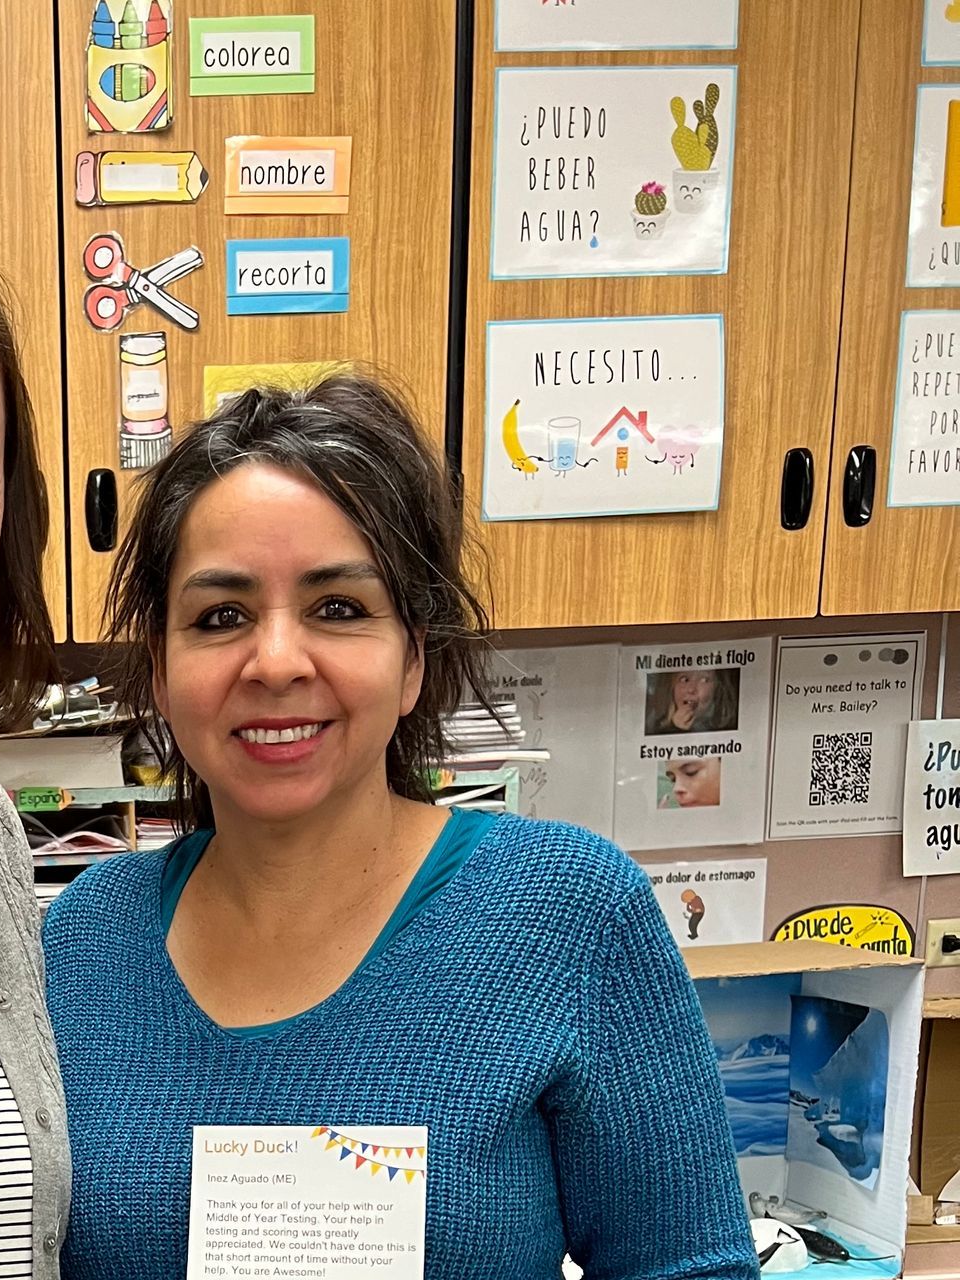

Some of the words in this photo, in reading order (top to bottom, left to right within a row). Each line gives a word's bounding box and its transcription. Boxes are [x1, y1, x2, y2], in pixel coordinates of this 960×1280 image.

[203, 41, 290, 67] colorea
[520, 105, 608, 146] ¿PUEDO
[240, 160, 326, 186] nombre
[528, 156, 596, 191] BEBER
[520, 209, 600, 248] AGUA?
[238, 260, 326, 287] recorta
[534, 349, 698, 387] NECESITO...
[929, 408, 960, 435] POR
[655, 653, 693, 669] diente
[696, 650, 722, 667] está
[726, 649, 755, 666] flojo
[785, 684, 800, 695] Do
[803, 684, 822, 696] you
[825, 680, 852, 693] need
[855, 681, 867, 691] to
[870, 678, 891, 690] talk
[895, 679, 907, 689] to
[811, 702, 836, 714] Mrs.
[839, 699, 878, 714] Bailey?
[640, 744, 674, 760] Estoy
[677, 738, 742, 759] sangrando
[20, 789, 65, 808] Español
[665, 872, 692, 884] dolor
[694, 870, 706, 882] de
[708, 869, 756, 882] estomago
[204, 1139, 249, 1157] Lucky
[254, 1139, 299, 1154] Duck!
[207, 1173, 229, 1183] Inez
[230, 1173, 269, 1185] Aguado
[272, 1174, 297, 1185] (ME)
[207, 1199, 237, 1209] Thank
[240, 1201, 258, 1212] you
[261, 1200, 274, 1210] for
[276, 1200, 289, 1210] all
[290, 1200, 301, 1210] of
[303, 1202, 326, 1213] your
[328, 1201, 350, 1212] help
[353, 1201, 374, 1211] with
[376, 1203, 394, 1212] our
[206, 1212, 239, 1223] Middle
[241, 1212, 251, 1223] of
[254, 1213, 278, 1223] Year
[280, 1213, 321, 1226] Testing.
[323, 1214, 348, 1224] Your
[350, 1215, 372, 1226] help
[374, 1215, 384, 1225] in
[206, 1226, 239, 1238] testing
[241, 1226, 260, 1236] and
[262, 1228, 299, 1239] scoring
[302, 1229, 322, 1238] was
[324, 1228, 360, 1240] greatly
[206, 1240, 267, 1251] appreciated.
[269, 1240, 286, 1250] We
[288, 1240, 328, 1250] couldn't
[330, 1241, 356, 1251] have
[358, 1242, 384, 1252] done
[386, 1242, 405, 1252] this
[408, 1242, 417, 1252] is
[205, 1252, 224, 1262] that
[226, 1252, 251, 1262] short
[254, 1254, 292, 1264] amount
[294, 1254, 304, 1263] of
[306, 1254, 328, 1264] time
[330, 1255, 368, 1265] without
[370, 1258, 393, 1268] your
[204, 1265, 229, 1276] help.
[231, 1265, 251, 1276] You
[254, 1267, 270, 1276] are
[272, 1266, 326, 1278] Awesome!
